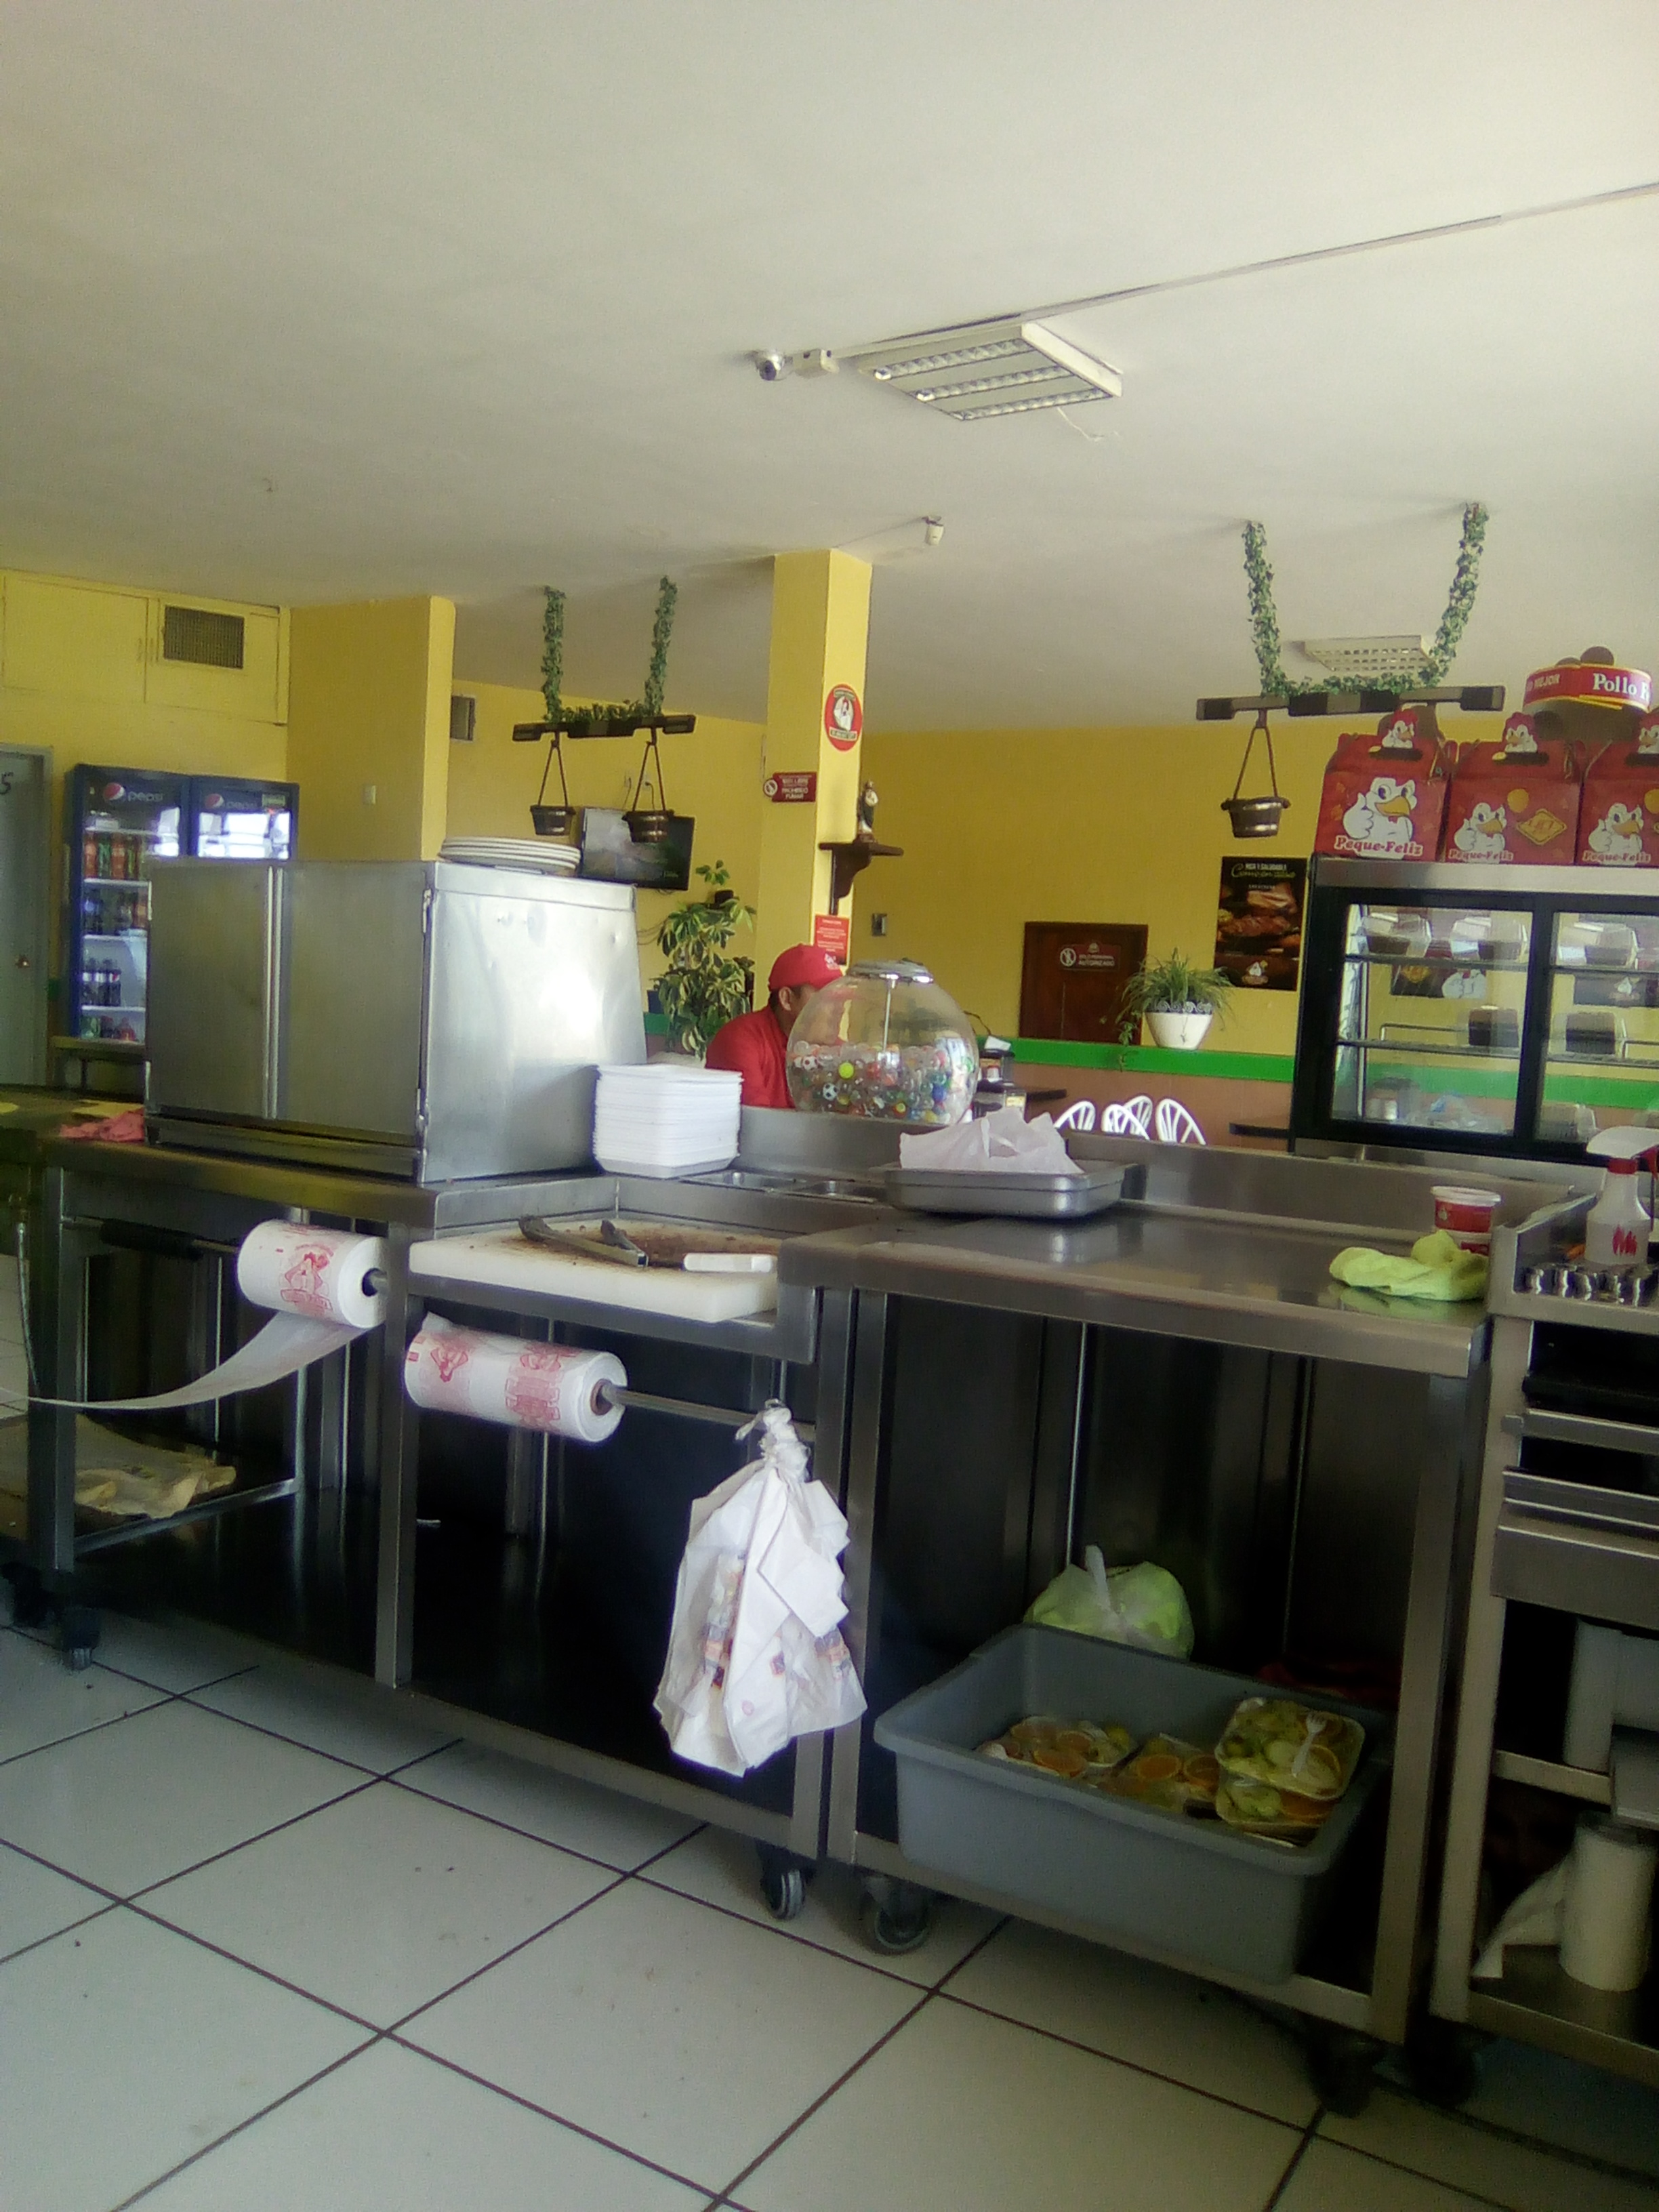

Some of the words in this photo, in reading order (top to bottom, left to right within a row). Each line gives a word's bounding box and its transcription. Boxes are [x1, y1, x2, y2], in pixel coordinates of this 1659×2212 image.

[1593, 673, 1637, 695] Pollo
[1334, 836, 1422, 856] Peque-Feliz
[1448, 848, 1513, 861] Peque-Feliz
[1583, 850, 1651, 863] Peque-Feliz
